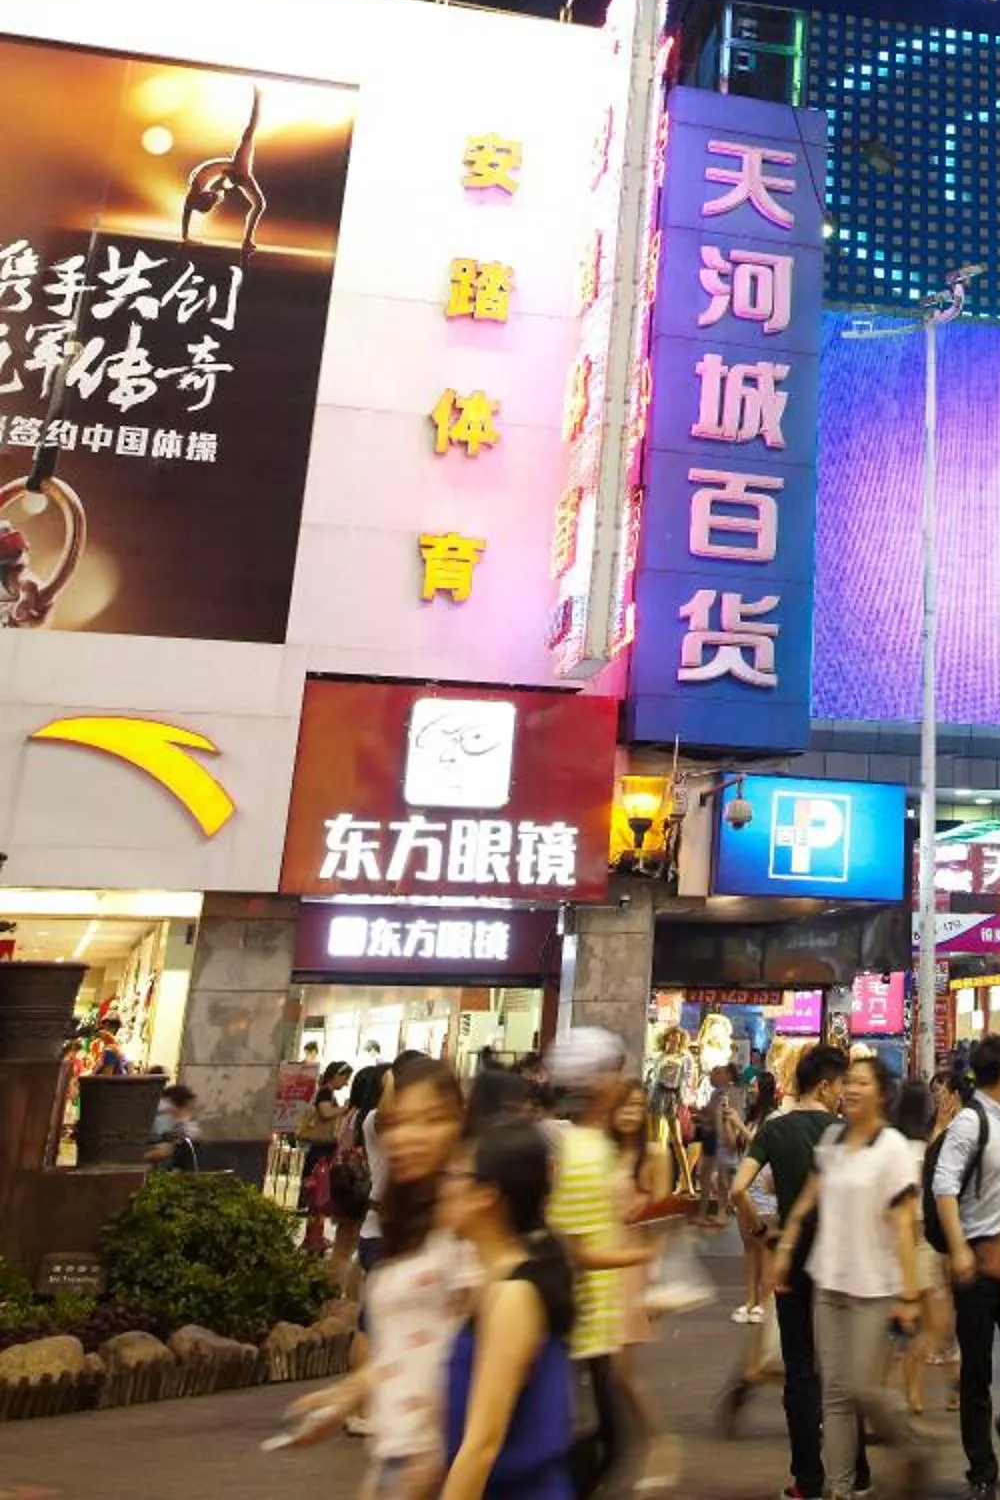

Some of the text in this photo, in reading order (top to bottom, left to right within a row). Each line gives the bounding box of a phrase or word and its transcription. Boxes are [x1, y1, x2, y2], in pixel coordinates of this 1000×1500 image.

[416, 131, 523, 602] 安踏体育
[678, 140, 797, 688] 天河城百货
[319, 812, 578, 887] 东方眼镜
[366, 917, 510, 960] 东方眼镜
